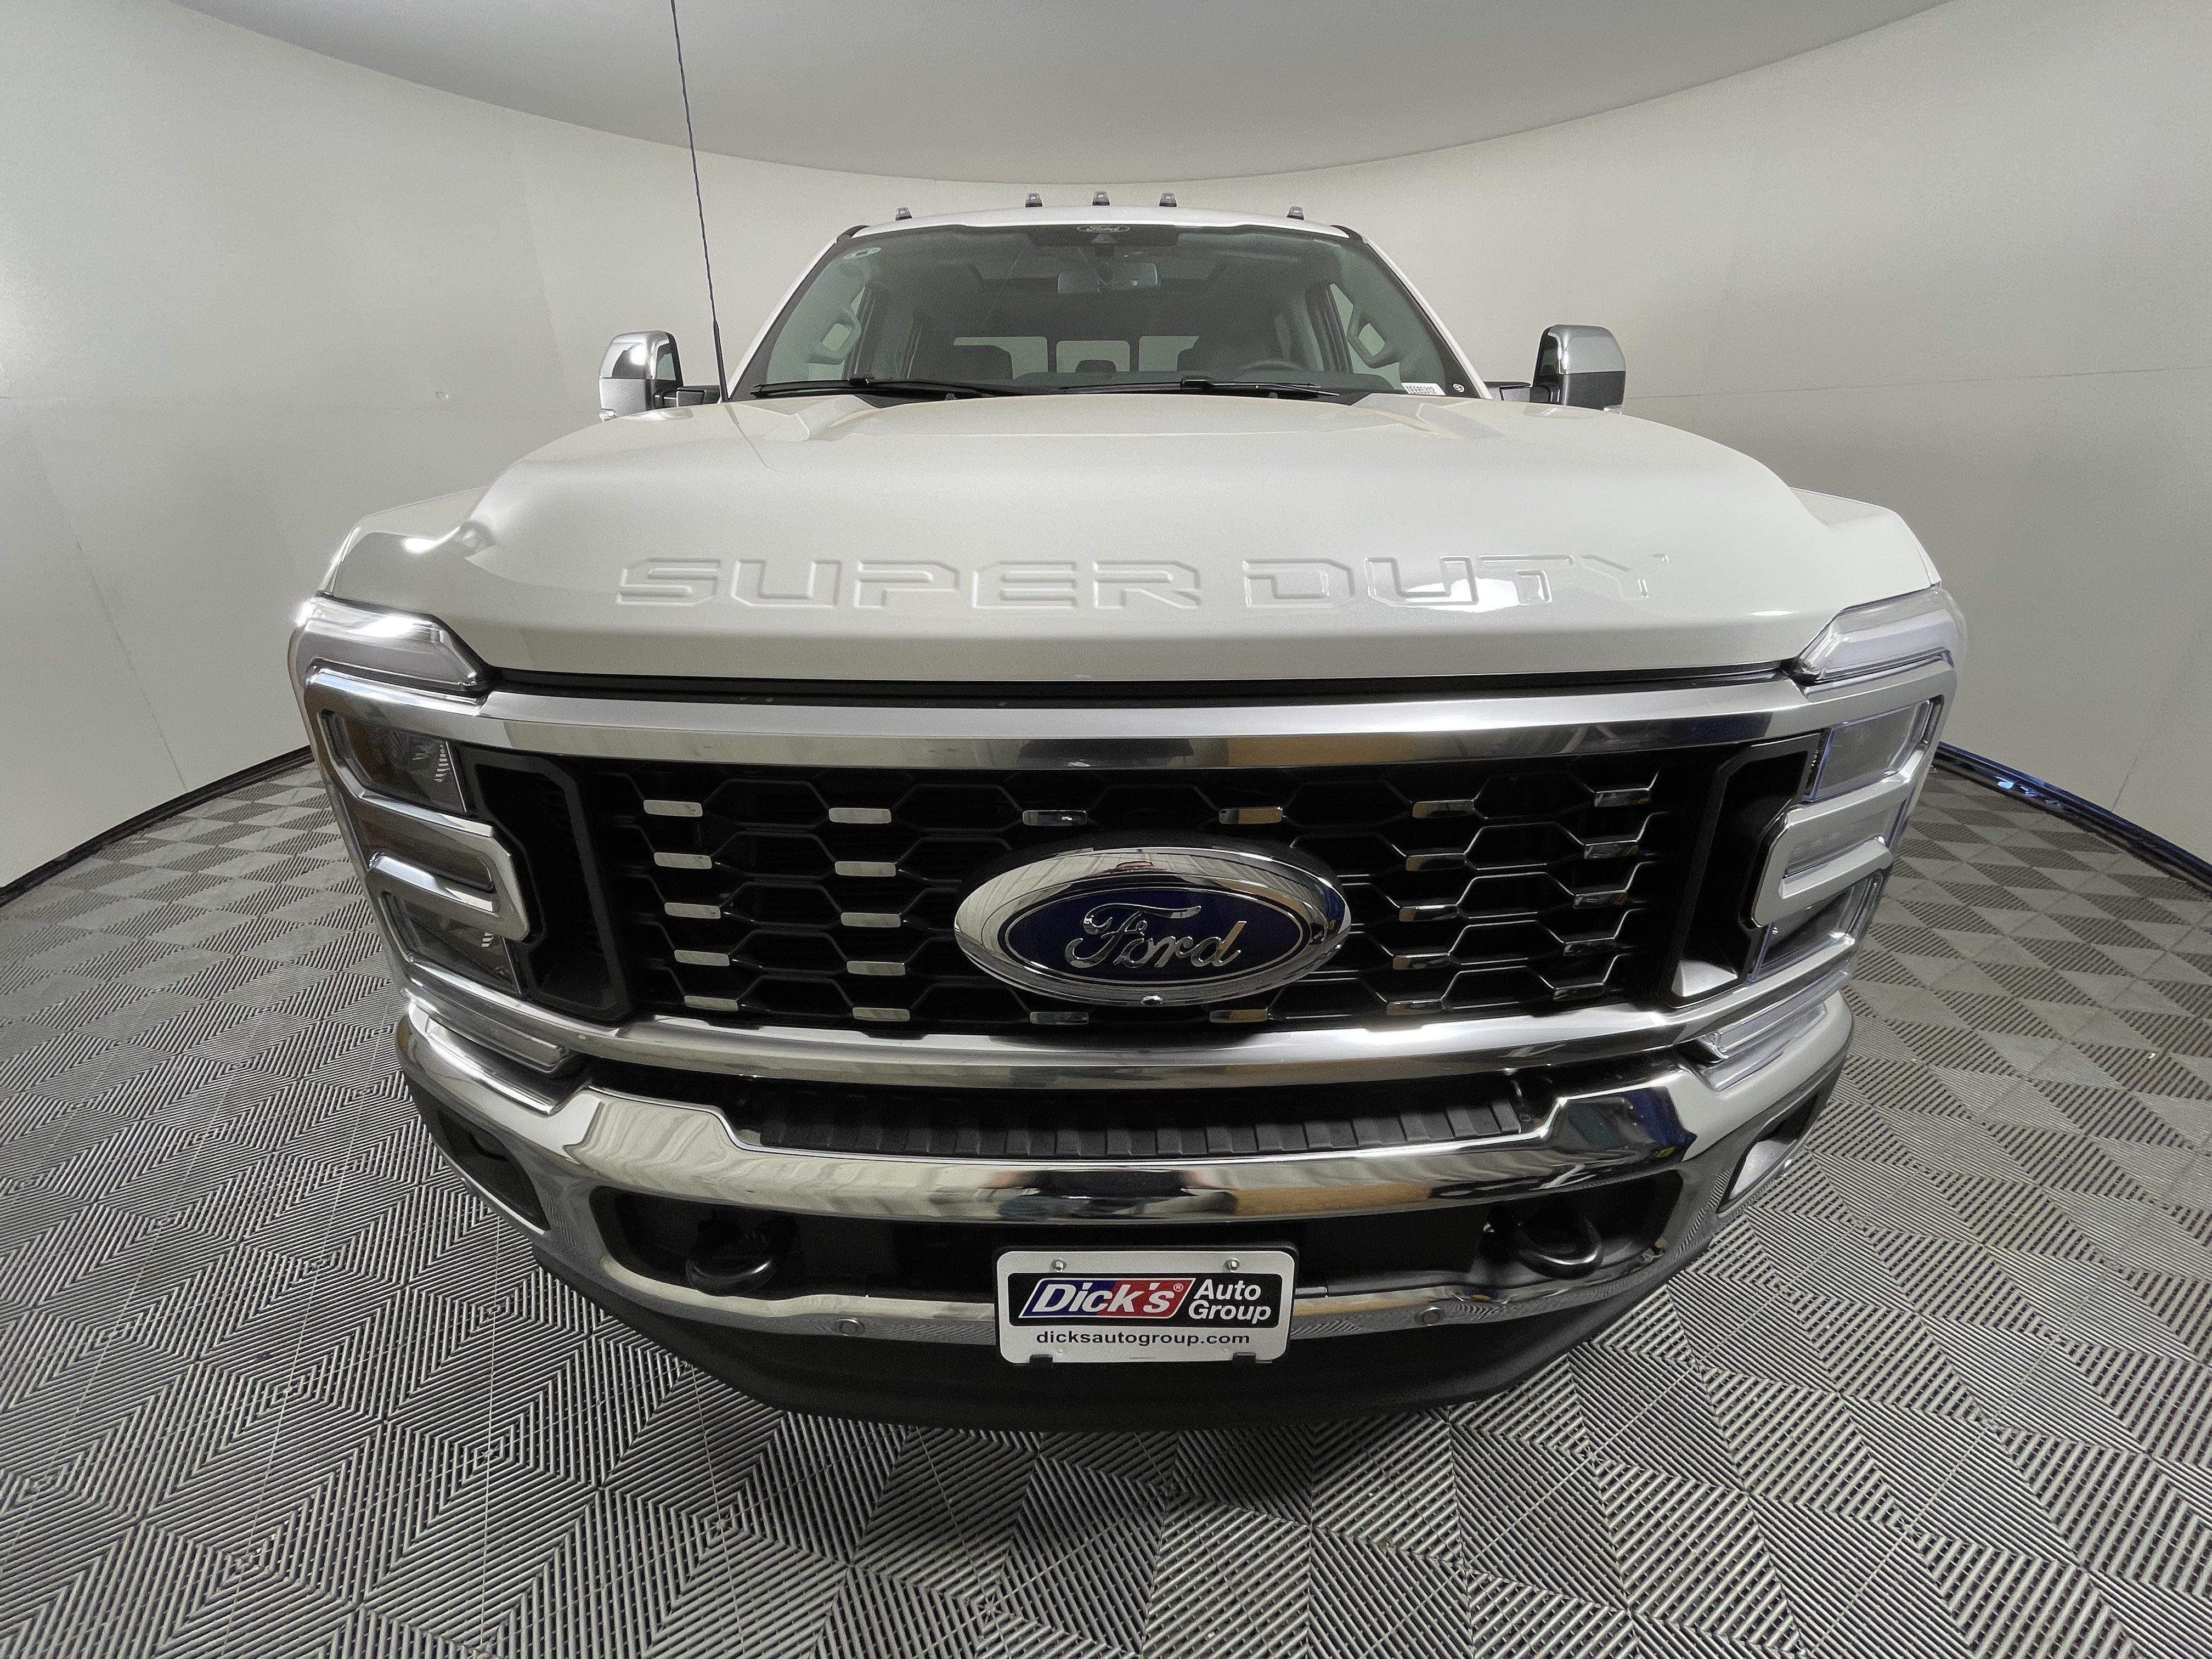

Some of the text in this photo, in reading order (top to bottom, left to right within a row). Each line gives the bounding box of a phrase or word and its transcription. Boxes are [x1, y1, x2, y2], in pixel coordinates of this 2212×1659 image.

[614, 554, 1670, 610] SUPER DUTY
[1064, 902, 1247, 968] Ford
[1194, 1279, 1261, 1301] Auto
[1188, 1300, 1272, 1323] Group
[1036, 1330, 1250, 1345] dicksautogroup.com
